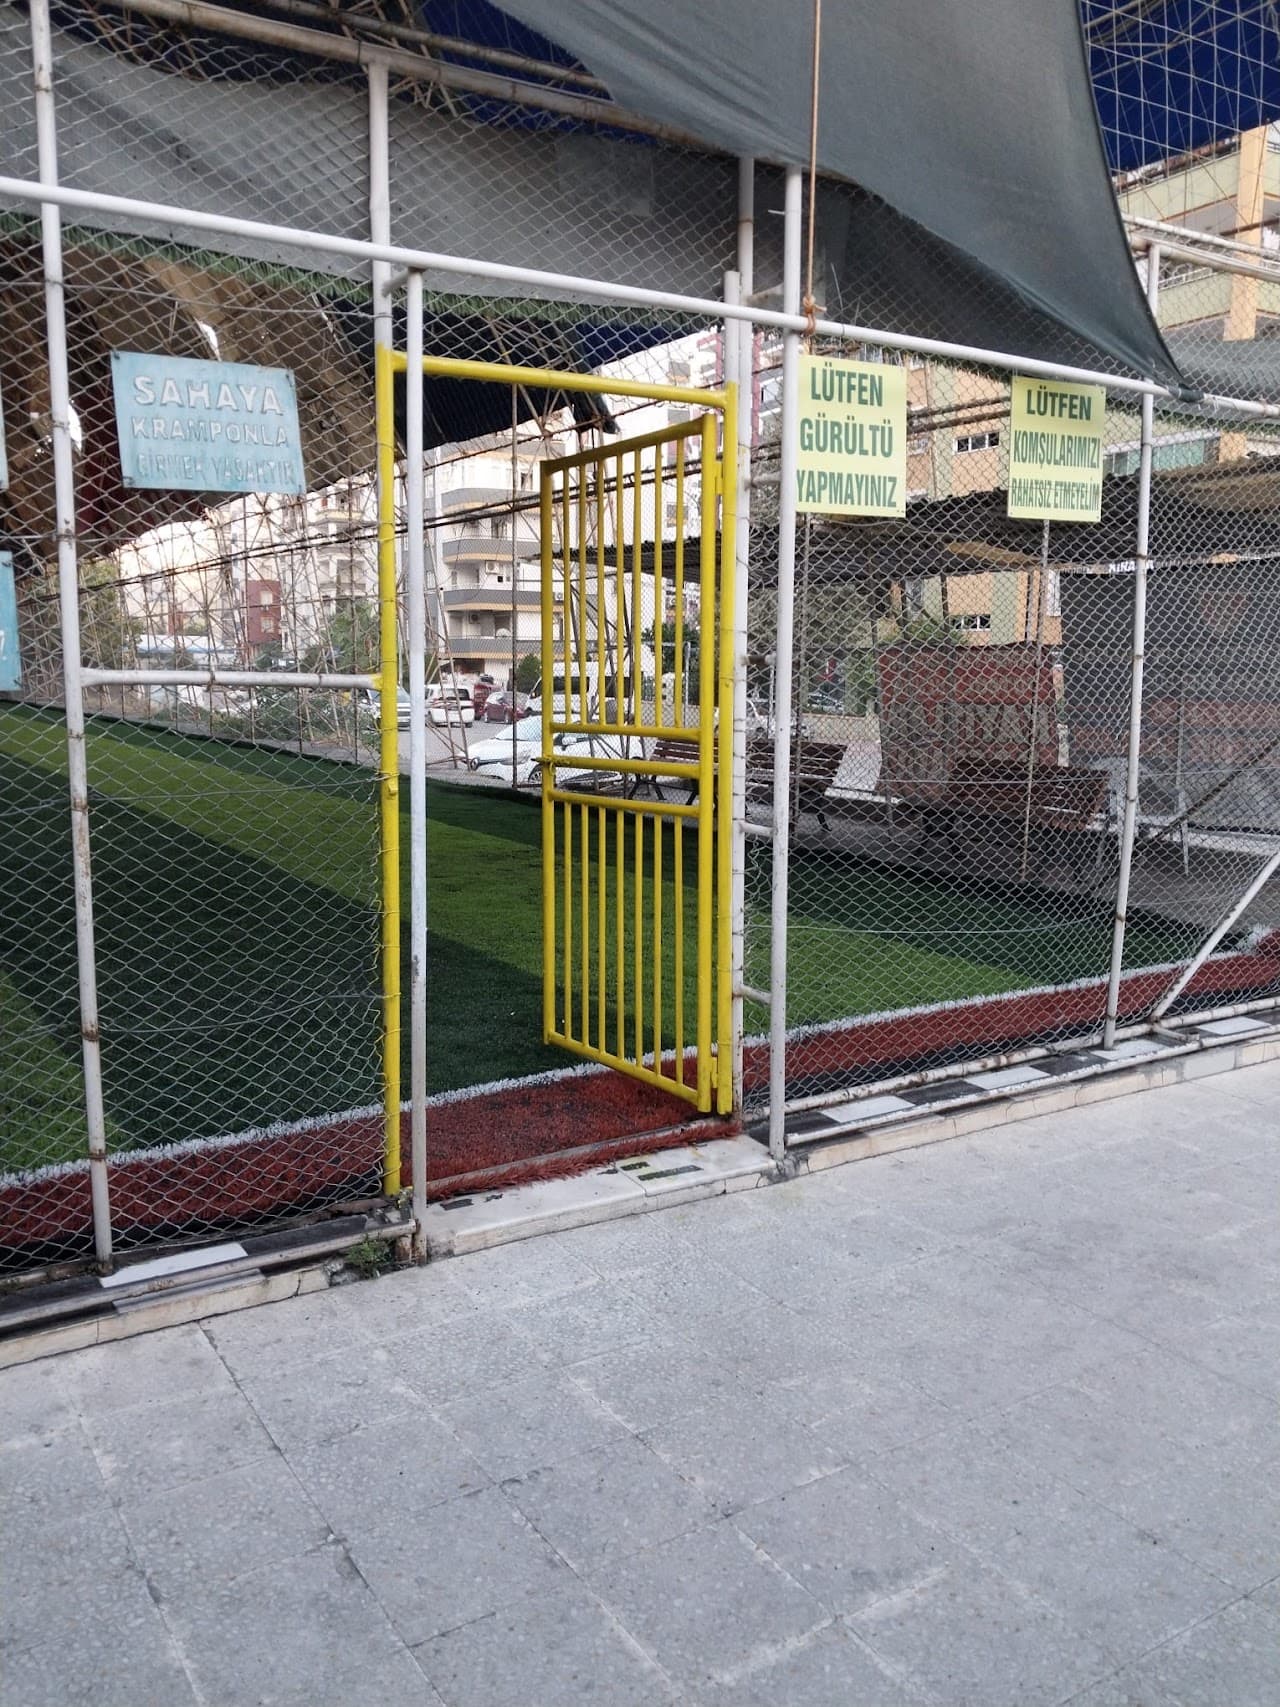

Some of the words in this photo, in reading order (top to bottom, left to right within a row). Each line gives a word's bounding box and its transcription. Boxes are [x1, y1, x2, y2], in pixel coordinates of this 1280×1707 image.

[133, 375, 284, 416] SAHAYA
[811, 362, 883, 407] LÜTFEN
[1026, 385, 1092, 421] LÜTFEN
[131, 416, 289, 448] KRAMPONLA
[800, 413, 893, 458] GÜRÜLTÜ
[1013, 430, 1101, 469] KOMŞULARIMIZI
[796, 469, 898, 508] YAPMAYINIZ
[1011, 478, 1052, 509] RAHATSIZ
[1054, 477, 1100, 511] ETMEYELİM
